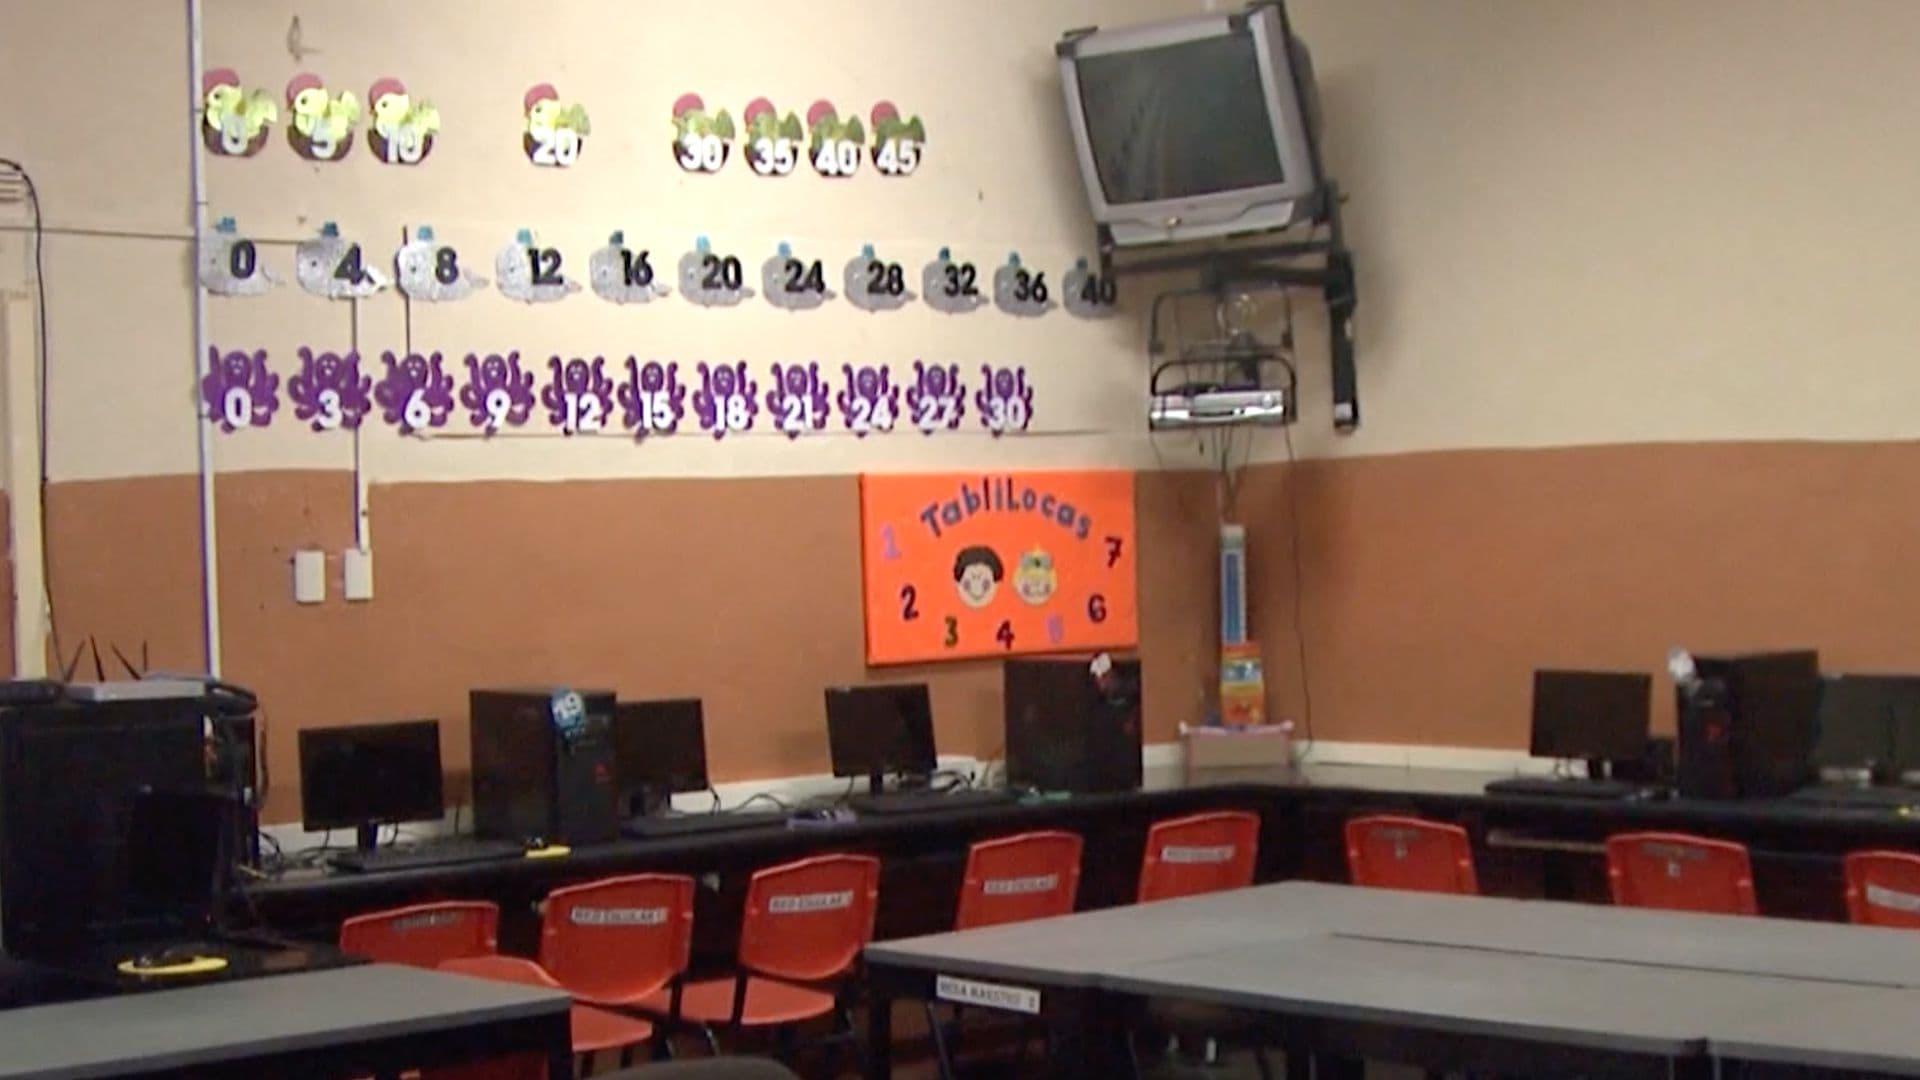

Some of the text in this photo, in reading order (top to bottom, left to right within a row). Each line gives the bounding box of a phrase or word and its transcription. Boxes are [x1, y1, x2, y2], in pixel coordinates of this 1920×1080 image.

[222, 115, 248, 154] 0
[312, 118, 337, 159] 5
[381, 122, 421, 162] 10
[532, 127, 579, 166] 20
[681, 135, 723, 171] 30
[755, 138, 793, 174] 35
[815, 140, 857, 177] 40
[877, 138, 917, 175] 45
[230, 240, 256, 279] 0
[333, 242, 370, 286] 4
[435, 246, 459, 285] 8
[527, 248, 563, 285] 12
[620, 249, 654, 286] 16
[700, 254, 743, 290] 20
[784, 259, 826, 293] 24
[867, 260, 904, 295] 28
[944, 262, 978, 297] 32
[1014, 269, 1048, 302] 36
[1081, 273, 1118, 306] 40
[224, 386, 251, 428] 0
[316, 387, 343, 430] 3
[404, 387, 432, 430] 6
[485, 389, 511, 430] 9
[564, 393, 600, 433] 12
[641, 391, 674, 431] 15
[714, 393, 749, 432] 18
[783, 393, 814, 432] 21
[850, 397, 893, 431] 24
[918, 396, 958, 430] 27
[989, 397, 1026, 430] 30
[882, 522, 900, 560] 1
[1105, 535, 1124, 568] 7
[900, 584, 919, 622] 2
[1087, 593, 1107, 624] 6
[944, 615, 959, 648] 3
[996, 619, 1015, 650] 4
